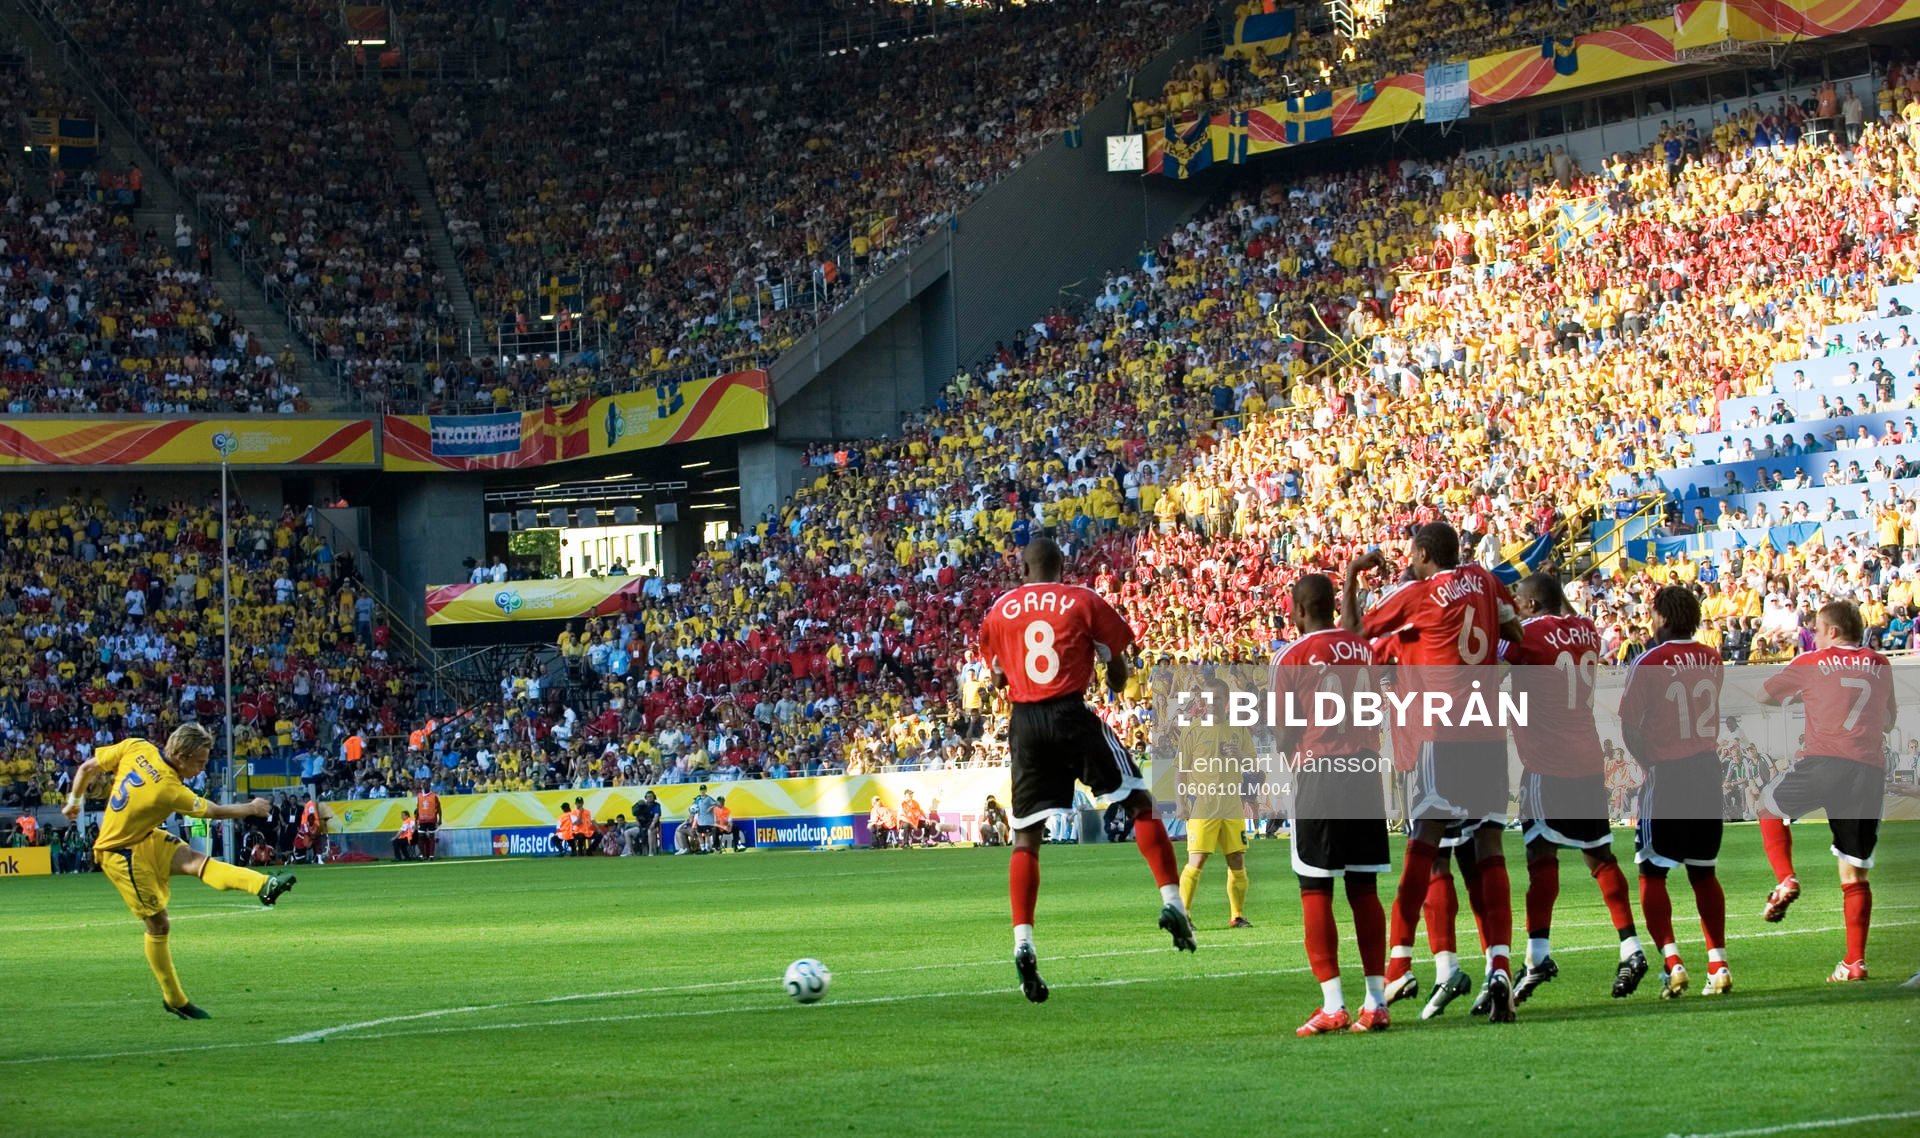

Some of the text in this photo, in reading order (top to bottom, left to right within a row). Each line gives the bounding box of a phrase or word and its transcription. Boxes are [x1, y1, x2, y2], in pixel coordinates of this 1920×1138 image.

[1002, 591, 1075, 619] GRAY
[1458, 604, 1488, 665] 6
[1544, 626, 1597, 649] YORKE
[1024, 620, 1060, 685] 8
[1329, 641, 1373, 666] JOHN
[1663, 652, 1720, 678] SAMUEL
[1554, 650, 1598, 709] 19
[1818, 655, 1883, 680] BIRCHALL
[1665, 679, 1717, 739] 12
[1840, 677, 1872, 731] 7
[110, 767, 146, 812] 5
[510, 832, 572, 854] MasterC
[757, 823, 854, 847] FIFAworldcup.com
